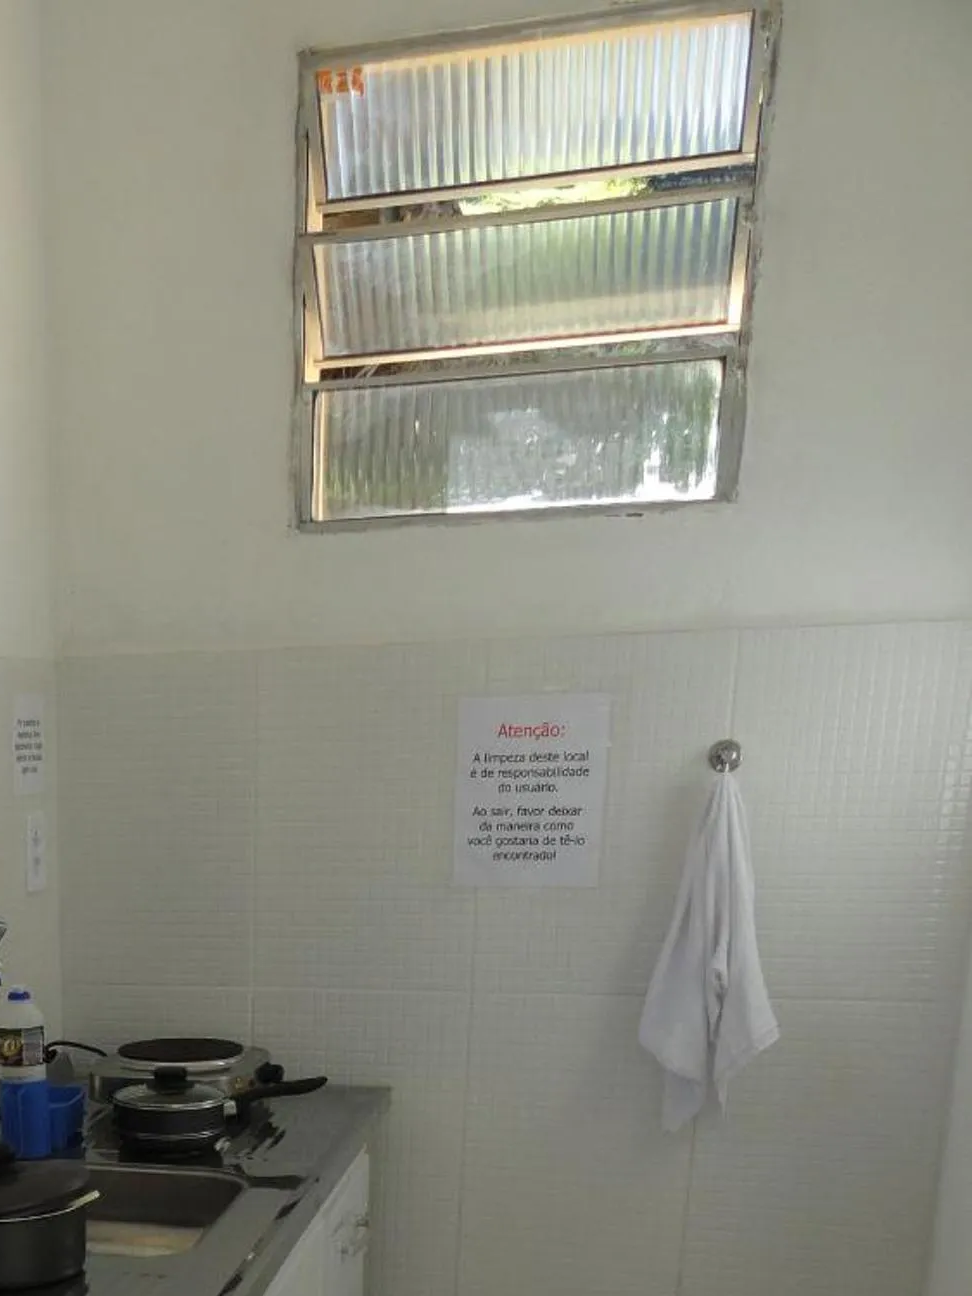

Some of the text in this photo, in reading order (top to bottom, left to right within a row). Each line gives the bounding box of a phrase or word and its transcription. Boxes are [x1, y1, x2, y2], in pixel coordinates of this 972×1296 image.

[497, 722, 566, 740] Atenção:
[473, 750, 589, 764] A limpeza deste local
[470, 767, 590, 779] é de responsabilidade
[498, 783, 558, 793] do usuário.
[472, 805, 583, 817] Ao sair, favor deixar
[479, 821, 574, 832] da maneira como
[468, 834, 585, 848] você gostaria de tê-lo
